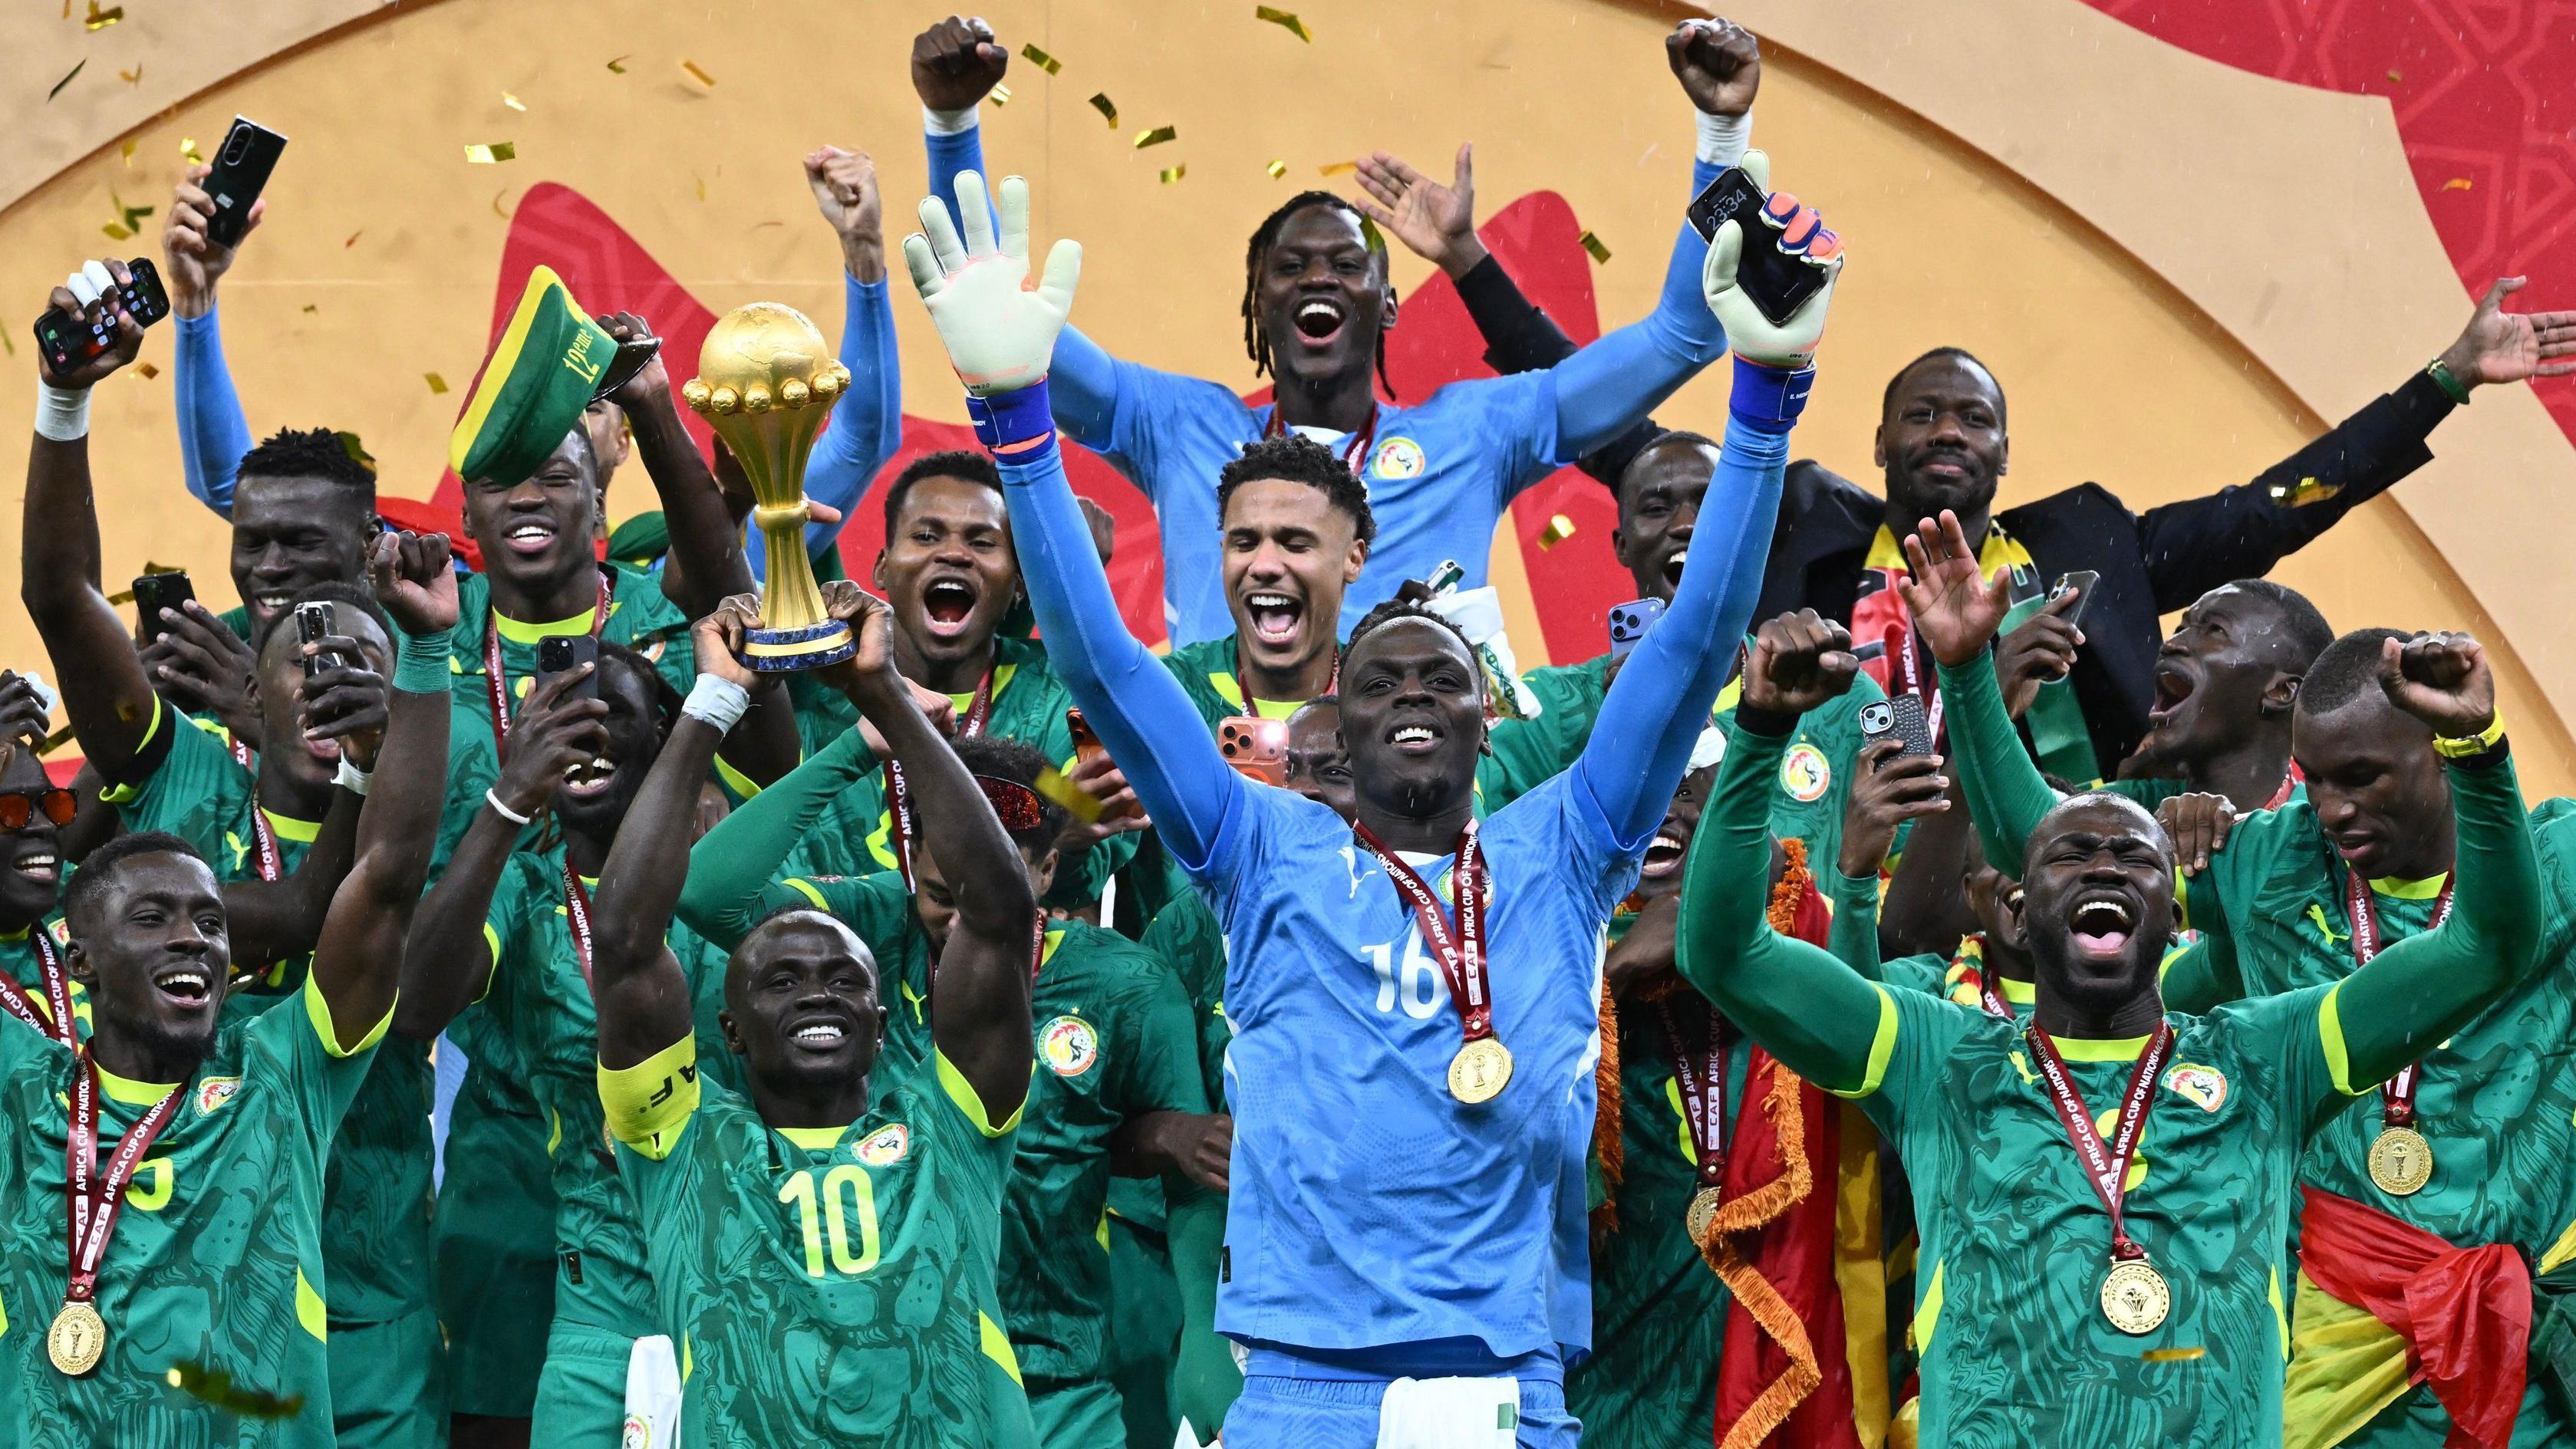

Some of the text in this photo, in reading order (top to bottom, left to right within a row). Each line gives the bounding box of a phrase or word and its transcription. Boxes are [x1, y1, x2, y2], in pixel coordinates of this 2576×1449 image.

[1707, 188, 1748, 232] 23:34
[894, 773, 906, 795] CUP
[1376, 852, 1409, 882] NATIONS
[1461, 871, 1473, 888] OF
[1402, 877, 1418, 891] OF
[1412, 888, 1431, 906] CUP
[1462, 888, 1474, 906] CUP
[571, 899, 591, 937] NATIONS
[1425, 904, 1449, 945] AFRICA
[1464, 907, 1476, 939] AFRICA
[2356, 897, 2372, 947] NATIONS
[1360, 917, 1451, 1019] 16
[1468, 946, 1477, 980] CAF
[2363, 947, 2374, 963] OF
[48, 964, 59, 980] OF
[3, 990, 24, 1010] CUP
[51, 980, 64, 999] CUP
[54, 999, 70, 1036] AFRICA
[1678, 1054, 1696, 1093] AFRICA
[1709, 1046, 1720, 1083] AFRICA
[2044, 1059, 2072, 1100] NATIONS
[2143, 1053, 2160, 1090] NATIONS
[651, 1063, 697, 1109] AF
[2134, 1087, 2147, 1102] OF
[77, 1105, 90, 1123] OF
[1710, 1094, 1718, 1126] CAF
[2064, 1098, 2078, 1113] OF
[2128, 1101, 2142, 1121] CUP
[77, 1122, 89, 1147] CUP
[2070, 1112, 2089, 1134] CUP
[2116, 1120, 2136, 1155] AFRICA
[2081, 1133, 2107, 1172] AFRICA
[76, 1149, 87, 1191] AFRICA
[90, 1210, 107, 1246] CAF
[104, 1158, 129, 1202] AFRICA
[121, 1137, 140, 1159] CUP
[133, 1123, 147, 1139] OF
[778, 1164, 881, 1278] 10
[2129, 1274, 2159, 1297] CHAMPION
